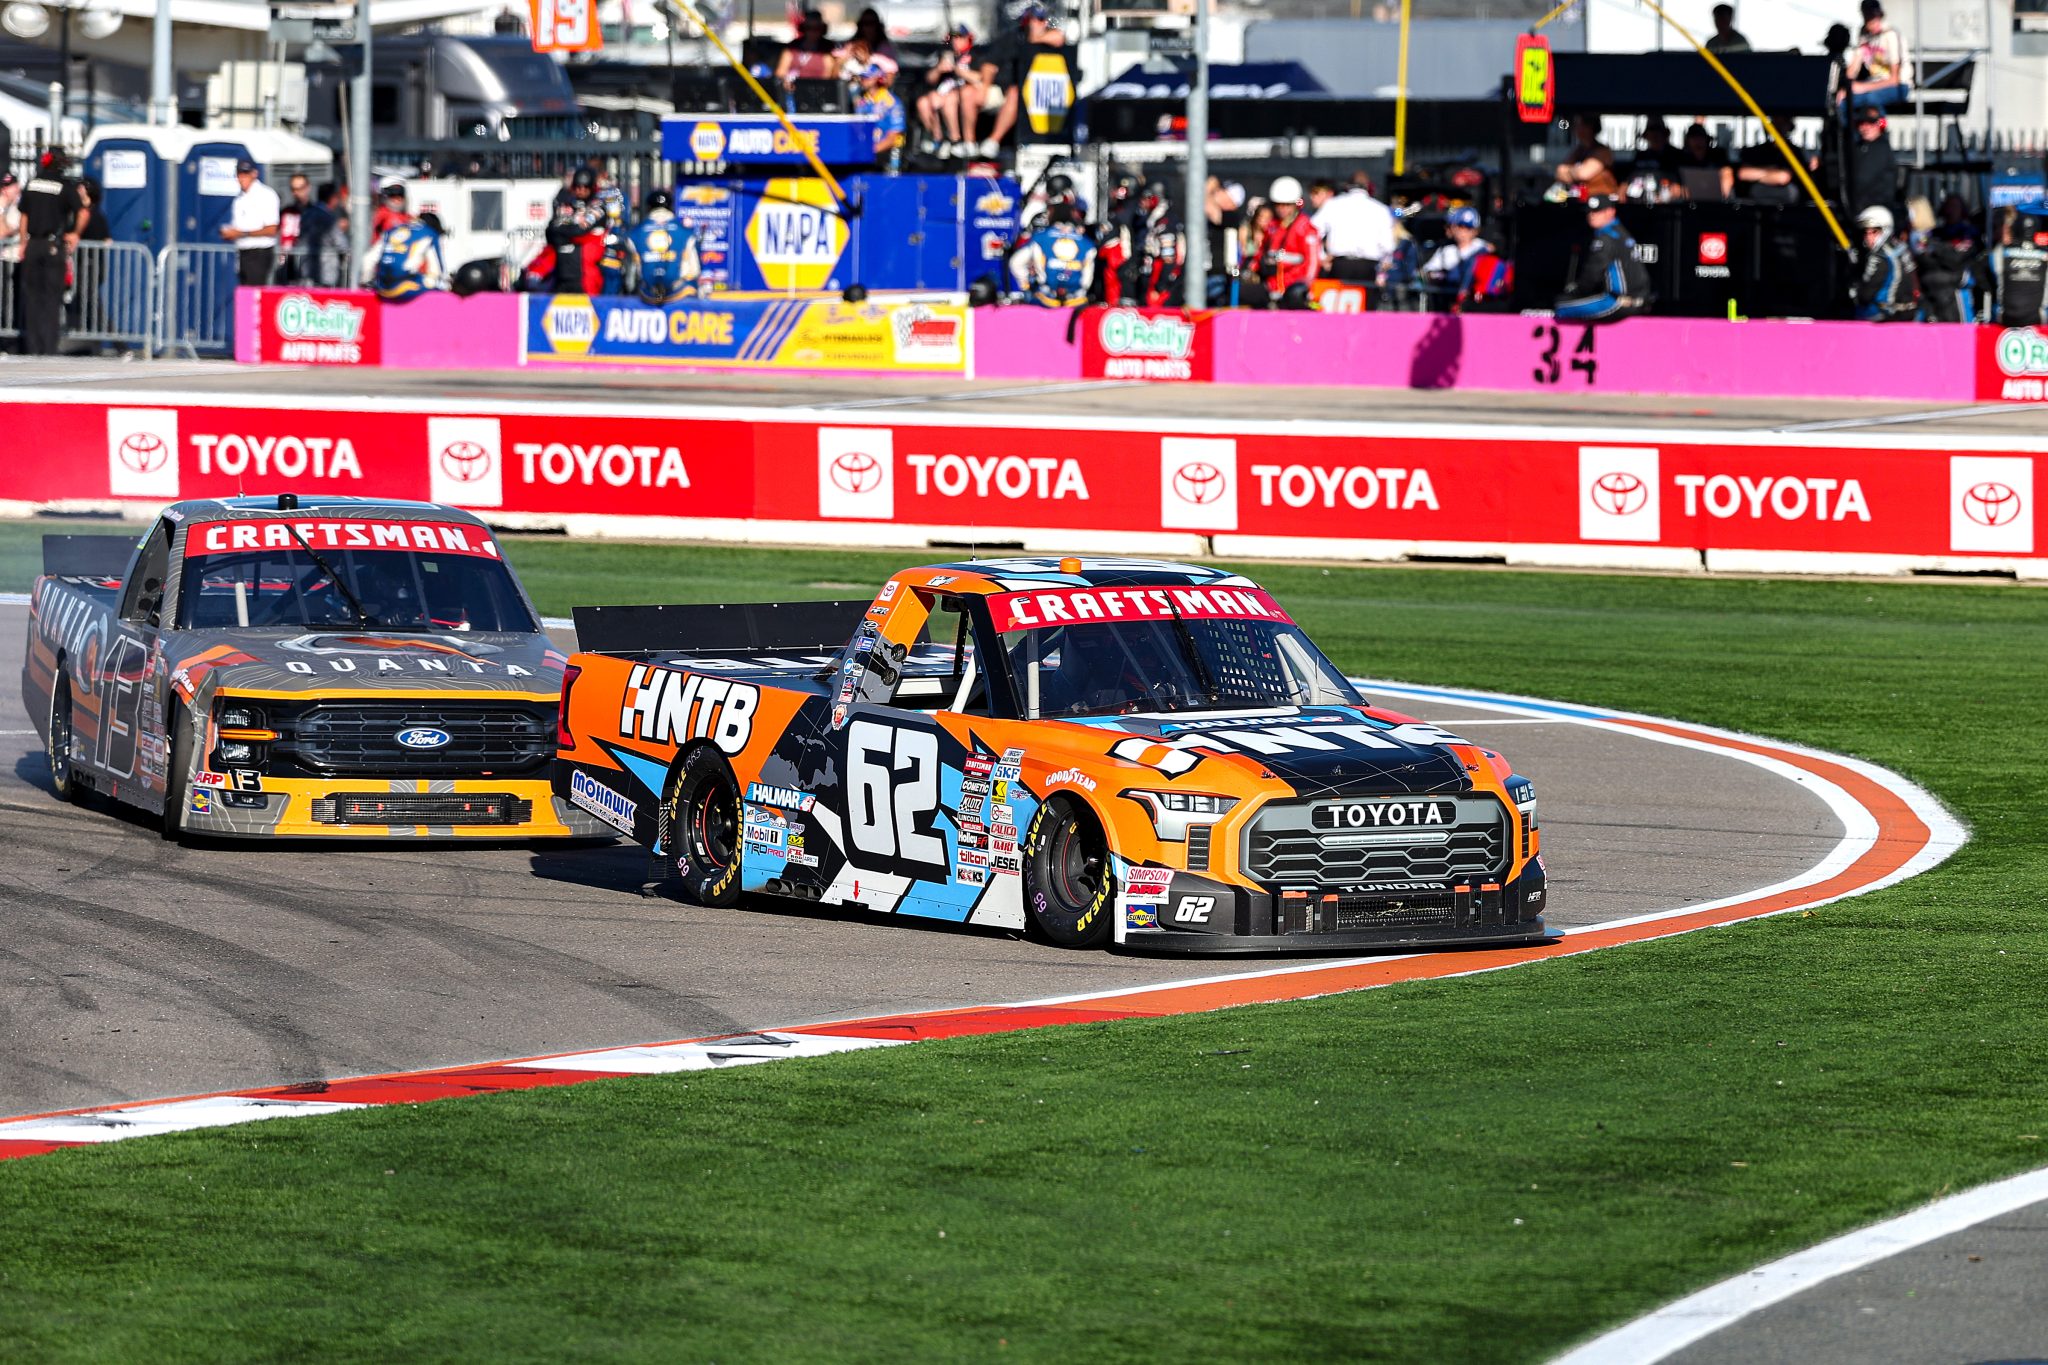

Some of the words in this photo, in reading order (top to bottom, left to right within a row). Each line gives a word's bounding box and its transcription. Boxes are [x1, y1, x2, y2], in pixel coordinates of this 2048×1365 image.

[764, 211, 831, 256] NAPA
[553, 308, 591, 335] NAPA
[605, 308, 668, 344] AUTO
[668, 310, 734, 345] CARE
[2001, 379, 2043, 400] AUTO
[190, 434, 363, 479] TOYOTA
[513, 442, 691, 488] TOYOTA
[906, 454, 1090, 500] TOYOTA
[1251, 464, 1440, 510] TOYOTA
[1674, 474, 1872, 521] TOYOTA
[206, 522, 471, 552] CRAFTSMAN
[1008, 589, 1272, 625] CRAFTSMAN
[285, 656, 533, 677] QUANTA
[620, 663, 759, 755] HNTB
[407, 730, 440, 746] Ford
[195, 771, 224, 785] ARP
[230, 766, 262, 792] 13
[994, 766, 1020, 780] SKF
[1045, 767, 1097, 793] GOODYEAR
[572, 771, 635, 822] MOHAWK
[670, 767, 688, 821] EAGLE
[752, 783, 801, 809] HALMAR
[846, 719, 946, 867] 62
[1327, 803, 1443, 828] TOYOTA
[746, 826, 769, 842] Mobil
[1026, 802, 1048, 858] EAGLE
[959, 850, 987, 866] tilton
[990, 855, 1020, 872] JESEL
[1128, 869, 1170, 882] SIMPSON
[1338, 882, 1447, 894] TUNDRA
[1126, 884, 1167, 895] ARP
[1127, 914, 1155, 923] SUNOCO
[1174, 896, 1215, 923] 62
